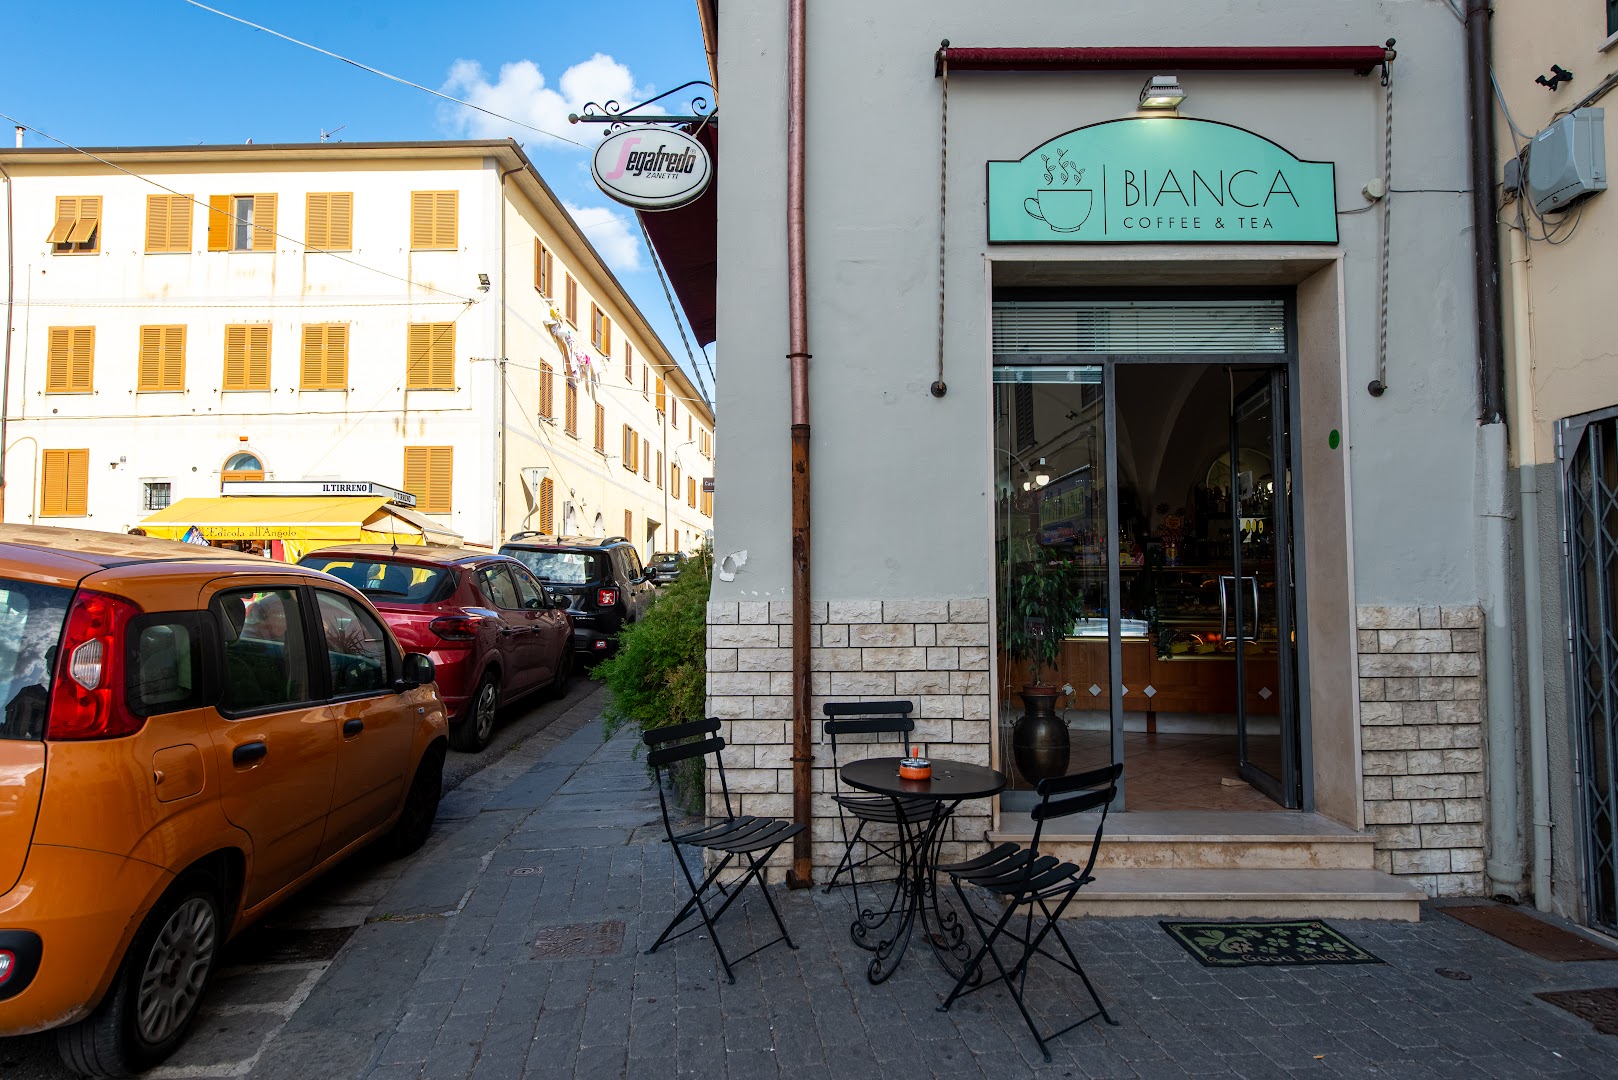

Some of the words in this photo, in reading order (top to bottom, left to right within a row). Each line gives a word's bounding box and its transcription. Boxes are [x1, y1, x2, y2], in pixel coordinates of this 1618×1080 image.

[605, 137, 697, 180] Segafredo
[645, 172, 679, 180] ZANETTI
[1124, 169, 1300, 208] BIANCA
[1123, 217, 1201, 229] COFFEE
[1214, 217, 1225, 229] &
[1237, 217, 1274, 229] TEA
[322, 484, 331, 492] IL
[330, 484, 367, 492] TIRRENO
[249, 527, 297, 538] all'Angolo
[1241, 954, 1296, 963] Good
